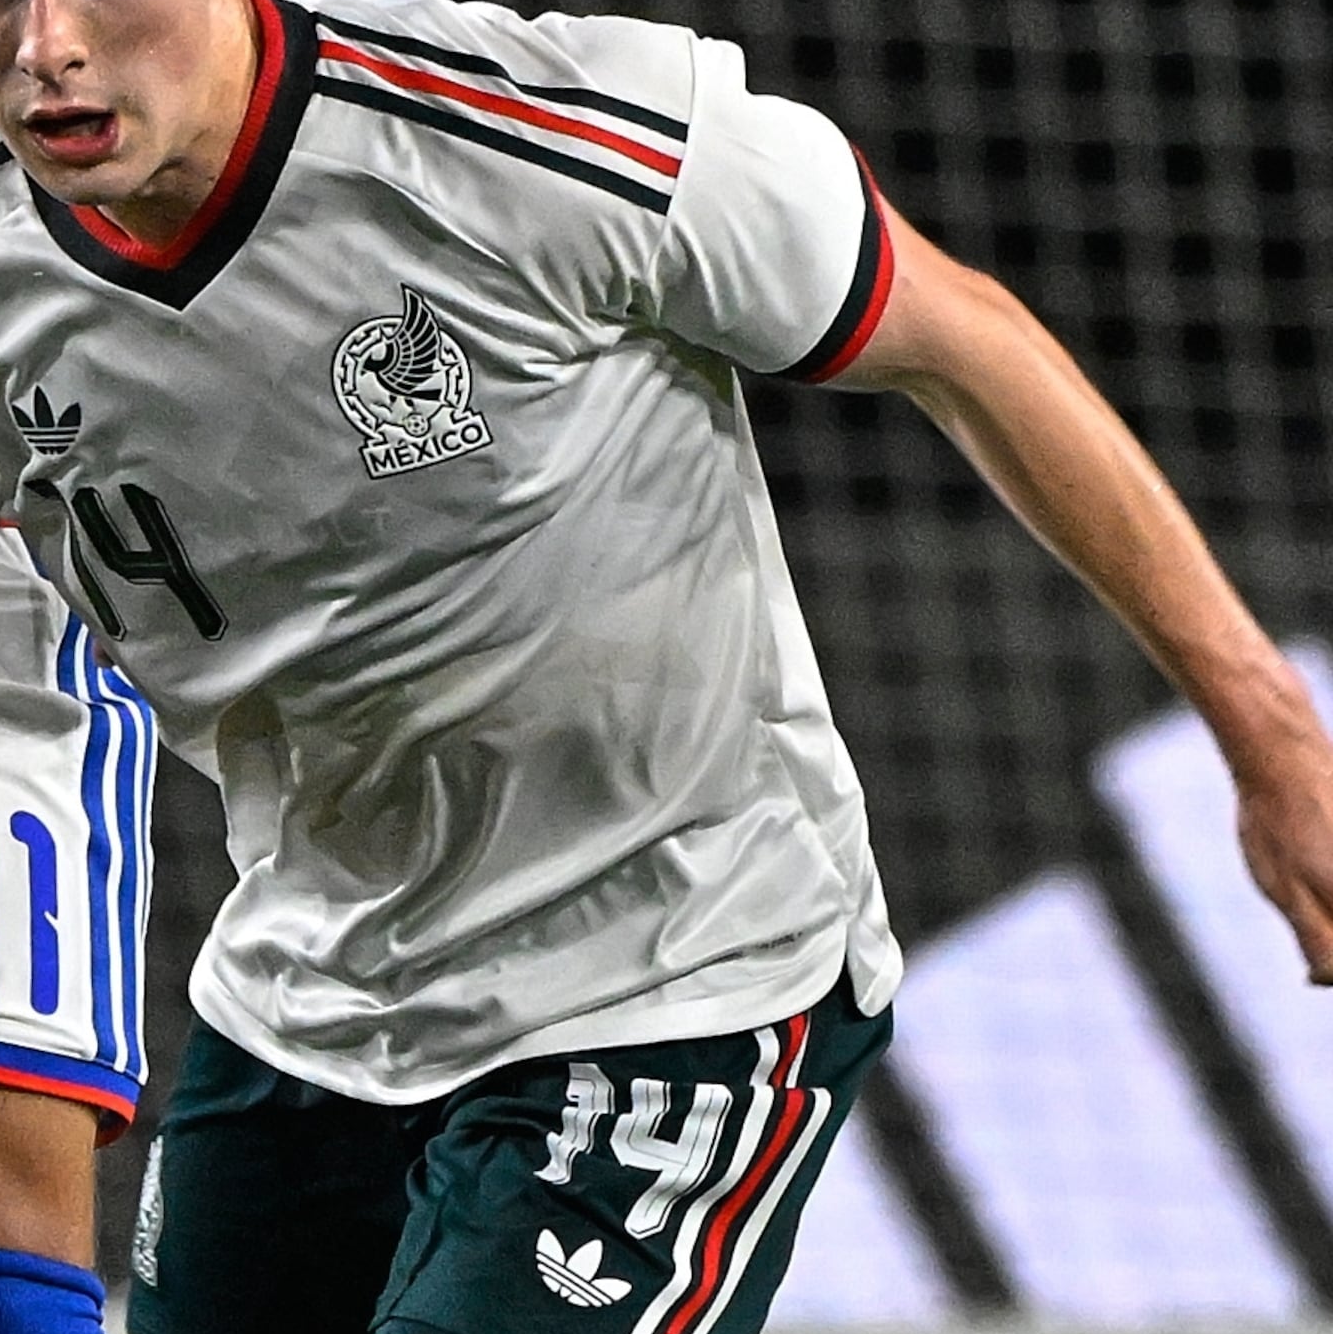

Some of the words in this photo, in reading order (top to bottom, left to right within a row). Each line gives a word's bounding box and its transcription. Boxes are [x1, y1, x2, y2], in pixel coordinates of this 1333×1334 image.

[369, 424, 483, 472] MÉXICO
[24, 478, 229, 642] 14
[533, 1062, 733, 1240] 14
